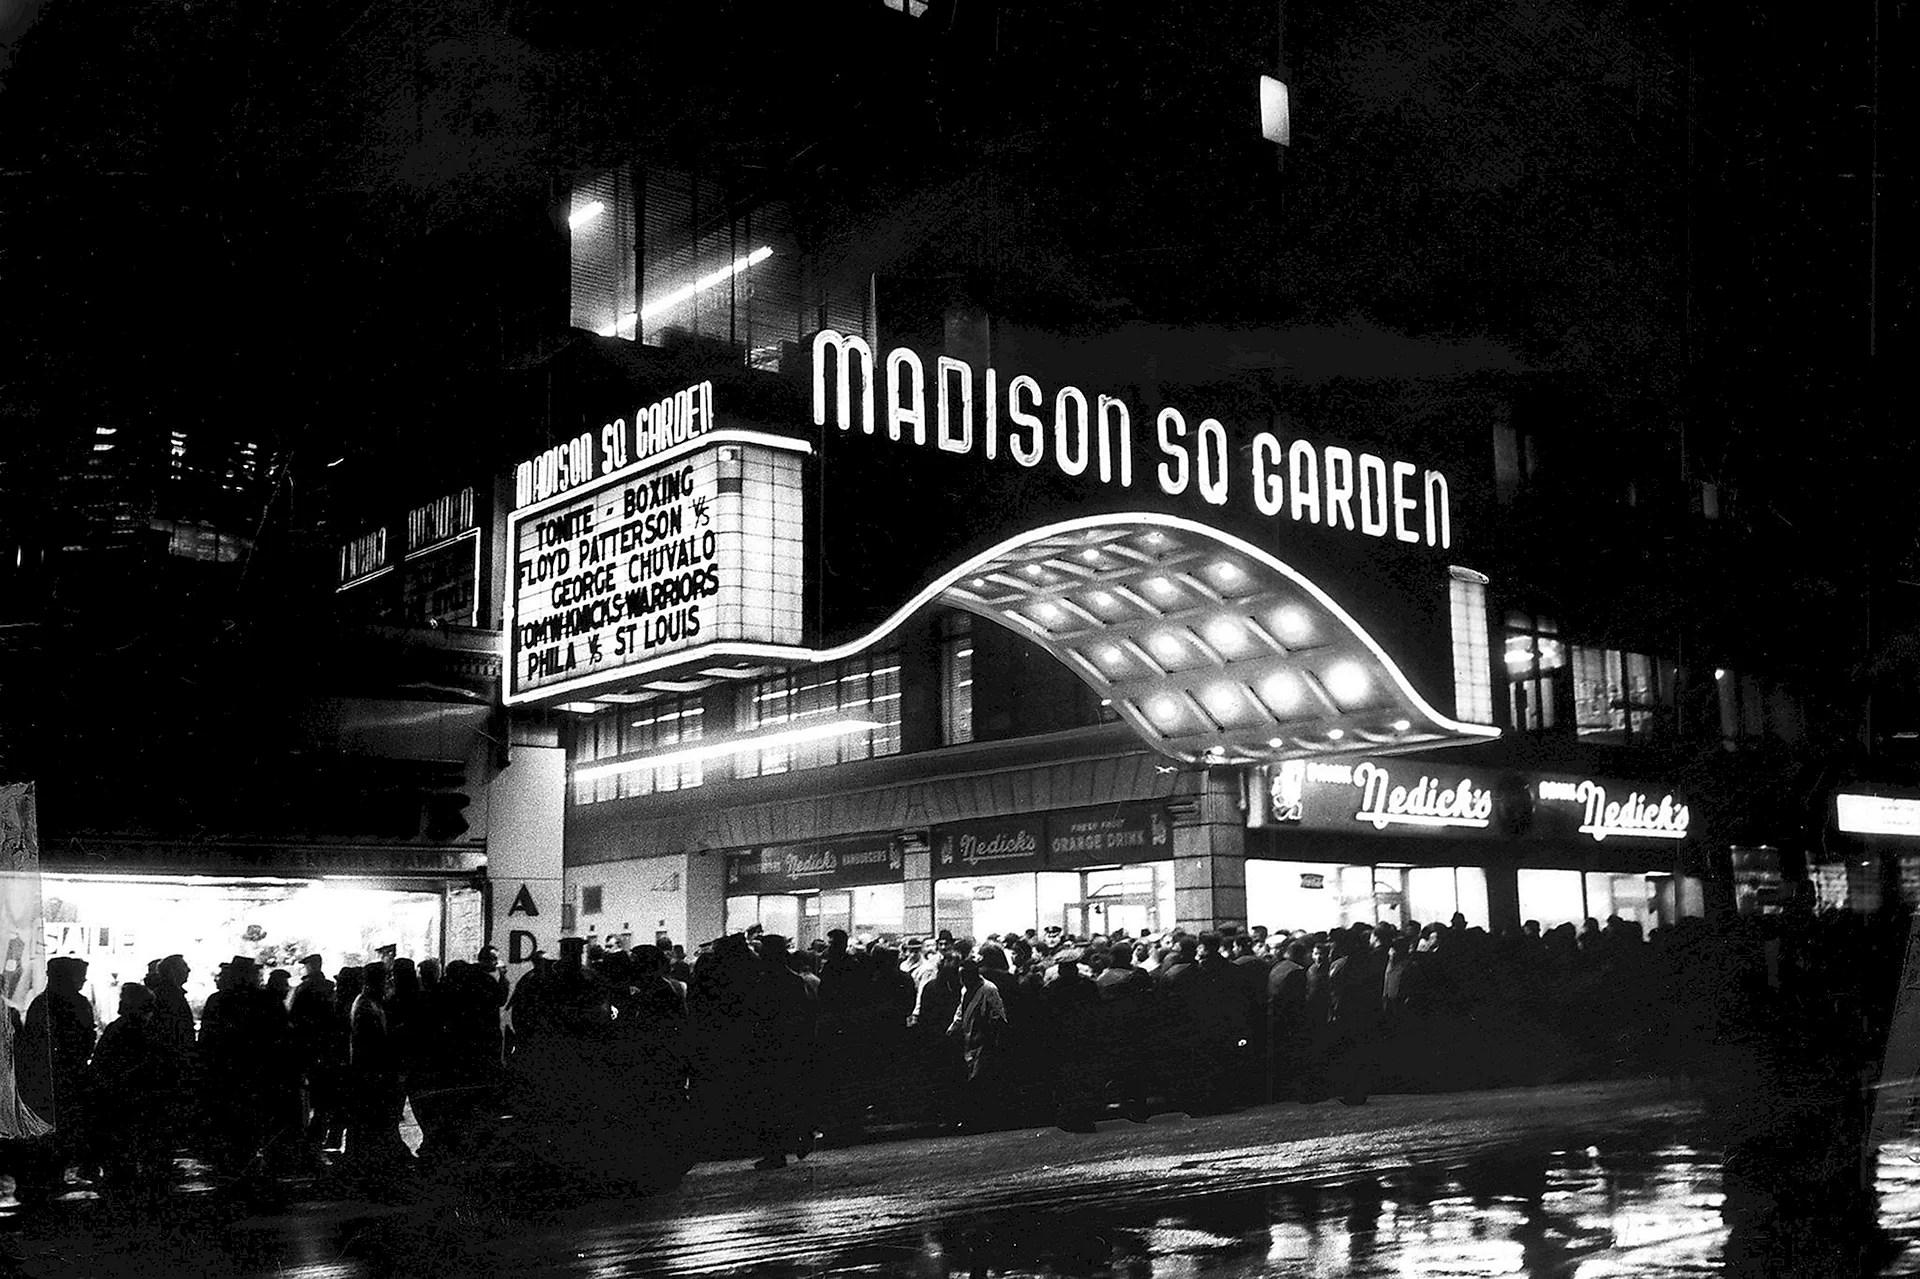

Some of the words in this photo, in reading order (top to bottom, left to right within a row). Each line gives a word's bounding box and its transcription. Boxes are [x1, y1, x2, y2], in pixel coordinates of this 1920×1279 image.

[515, 432, 593, 509] MADISON
[601, 418, 628, 475] SQ
[636, 380, 714, 459] GARDEN
[812, 329, 1132, 487] MADISON
[1157, 407, 1229, 505] SQ
[1252, 431, 1451, 549] GARDEN
[518, 547, 570, 591] FLOYD
[579, 504, 682, 568] PATTERSON
[536, 504, 594, 551] TONITE
[624, 465, 694, 519] BOXING
[552, 562, 617, 609] GEORGE
[628, 529, 716, 584] CHUVALO
[527, 642, 576, 681] PHILA
[615, 623, 637, 655] ST
[645, 605, 700, 649] LOUIS
[1353, 761, 1492, 829] Nedick's
[1576, 779, 1690, 841] Nedick's
